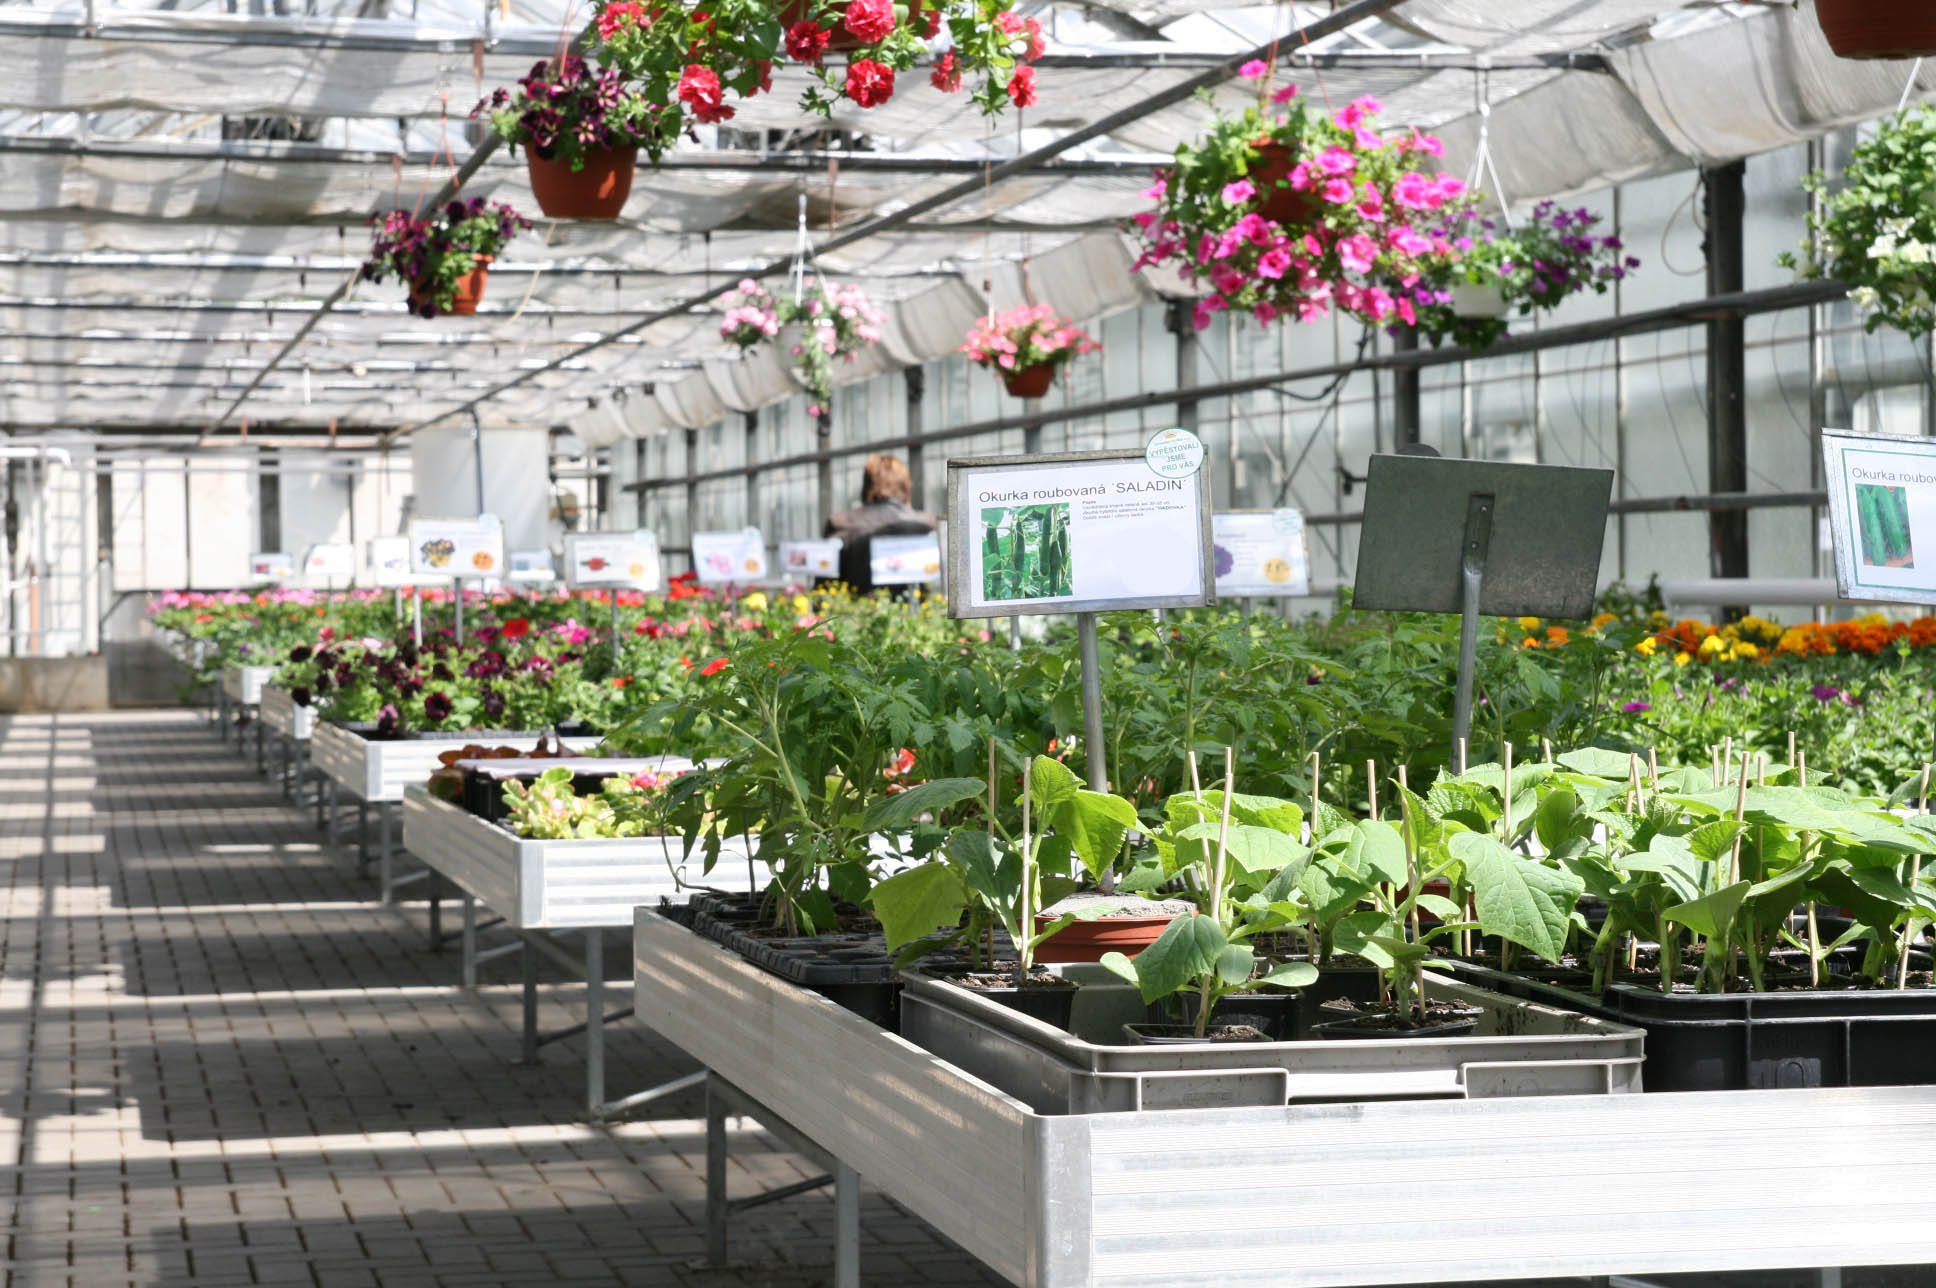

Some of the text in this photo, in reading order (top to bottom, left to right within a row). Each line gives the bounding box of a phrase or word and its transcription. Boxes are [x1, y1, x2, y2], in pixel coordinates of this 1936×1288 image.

[1162, 463, 1178, 472] PRO
[1852, 467, 1936, 483] Okurka roubo
[979, 490, 1029, 503] Okurka
[1033, 483, 1106, 499] roubovaná
